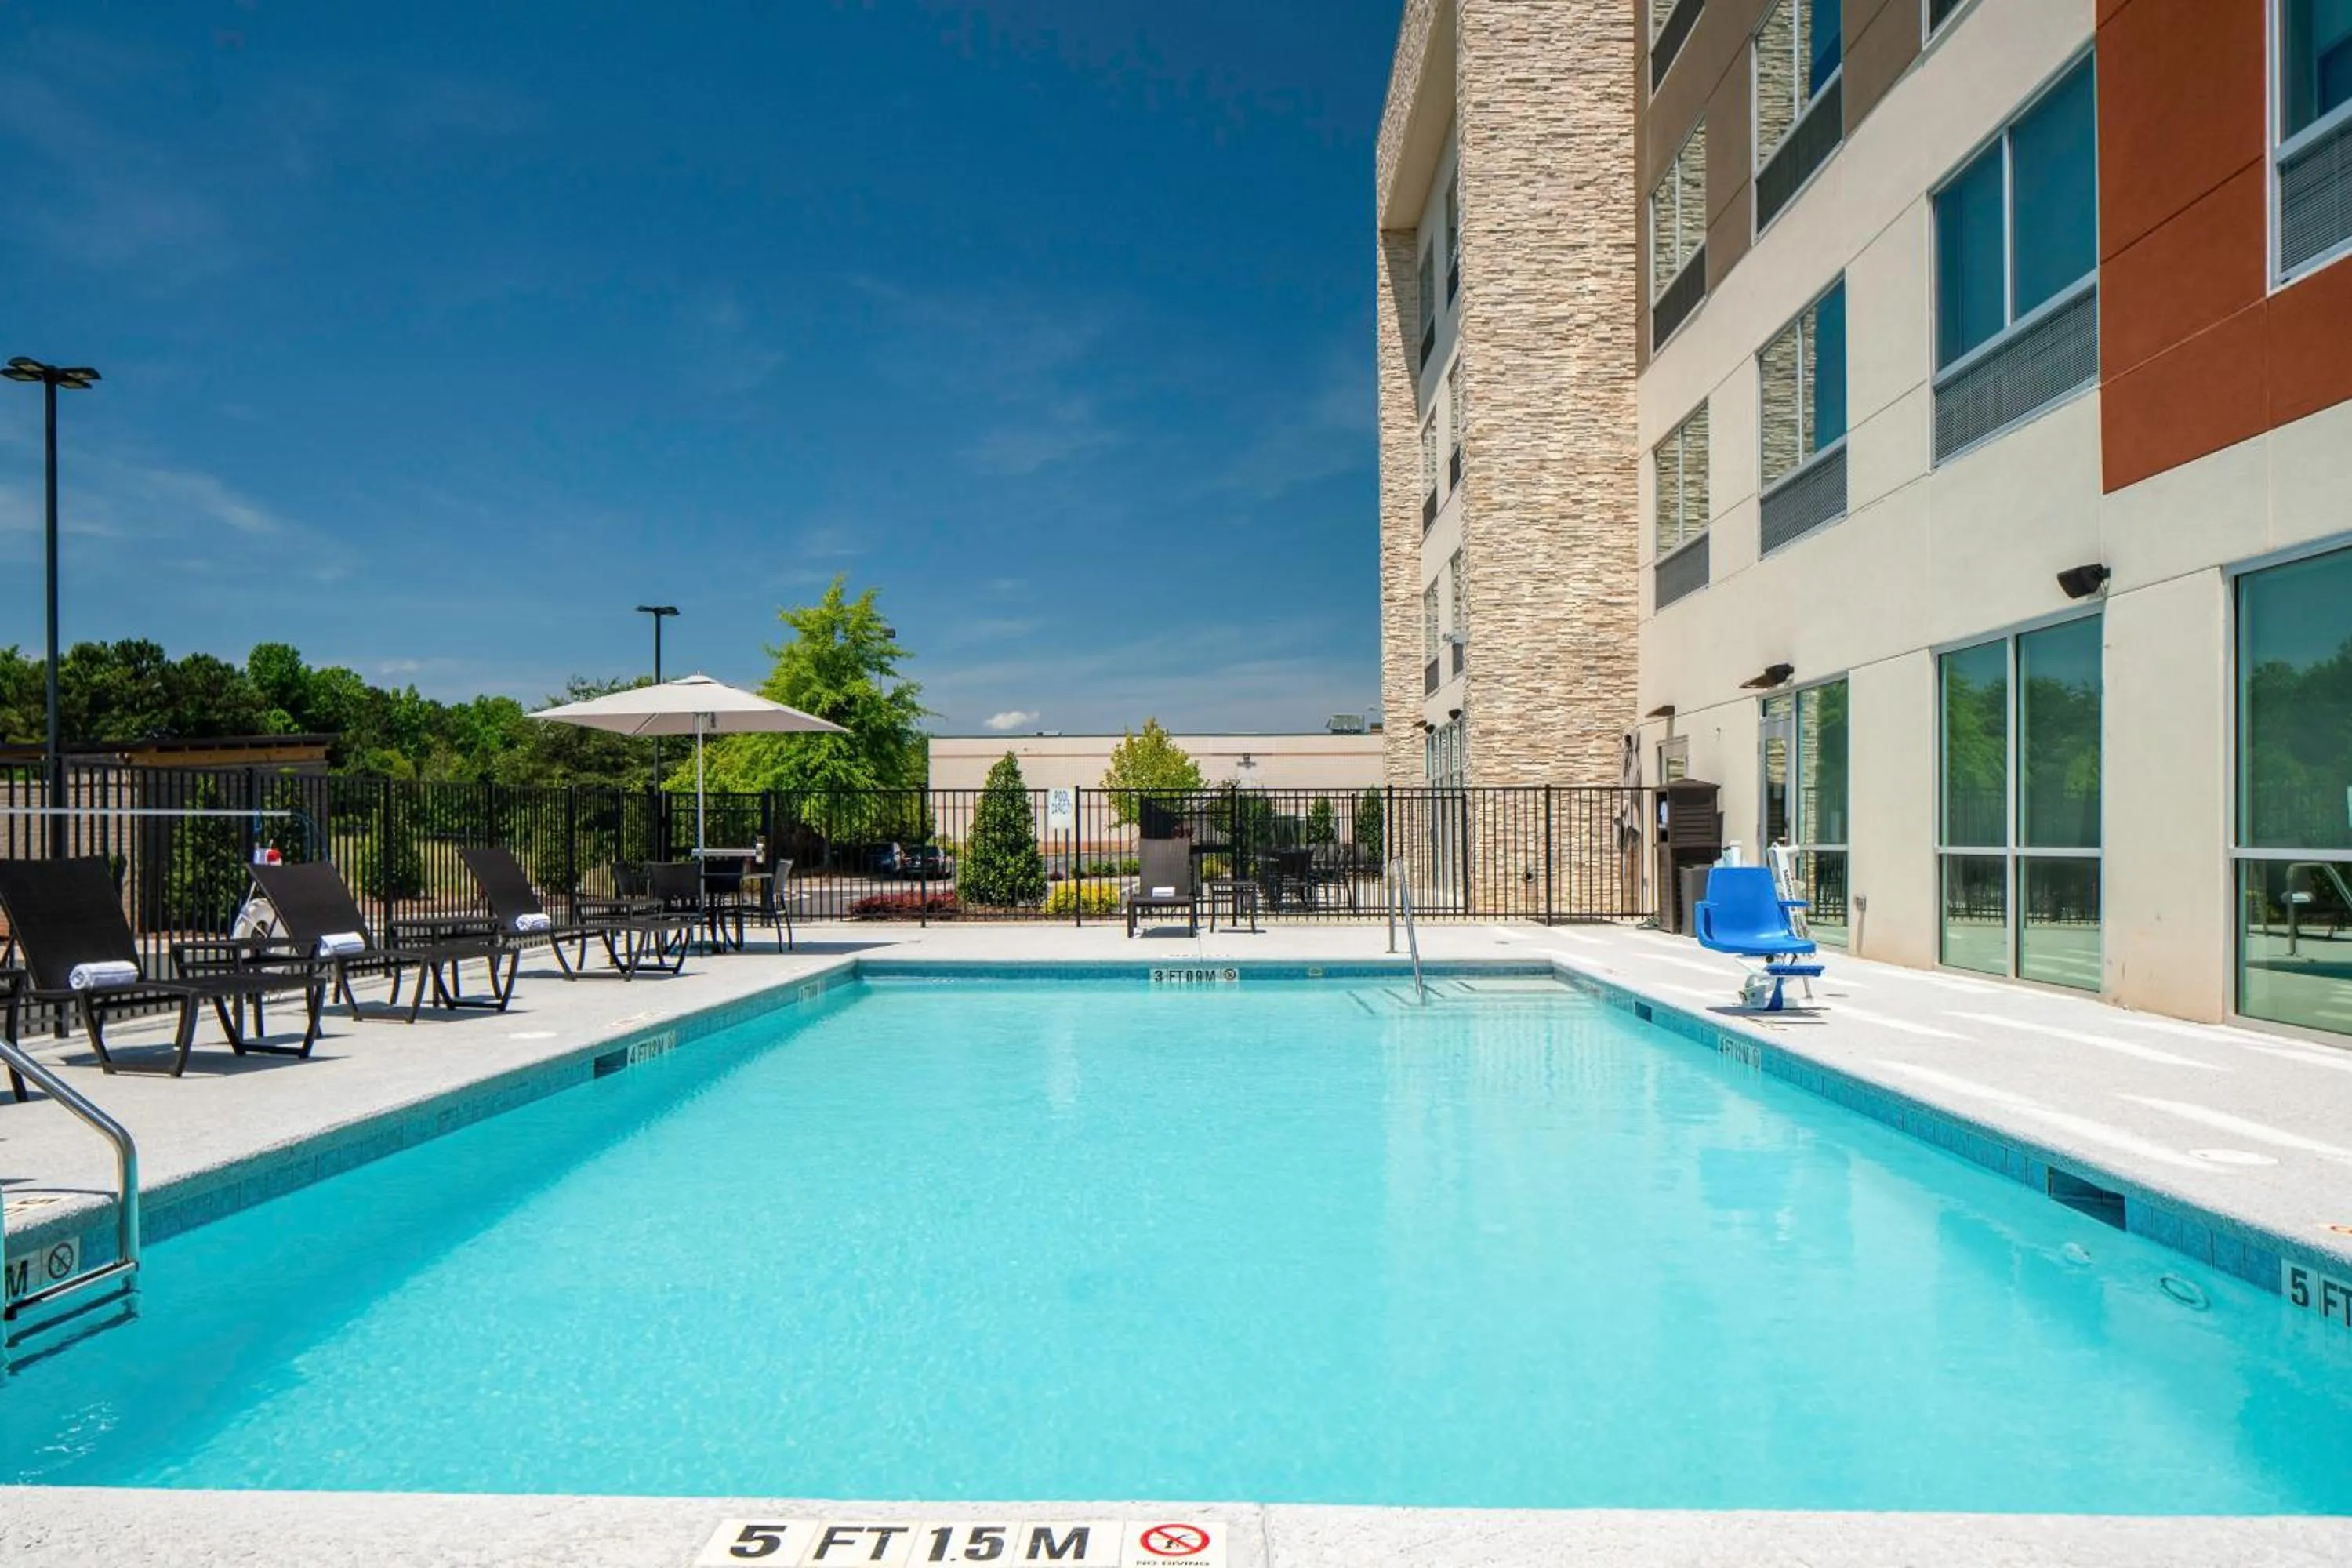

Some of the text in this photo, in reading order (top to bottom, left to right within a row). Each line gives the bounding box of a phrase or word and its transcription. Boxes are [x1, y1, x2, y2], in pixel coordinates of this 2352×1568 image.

[1154, 970, 1163, 982] 3
[1169, 970, 1184, 983] FT
[1205, 970, 1216, 982] M
[5, 1260, 27, 1300] M
[2291, 1267, 2309, 1308] 5
[730, 1525, 1090, 1562] 5 FT 1.5 M
